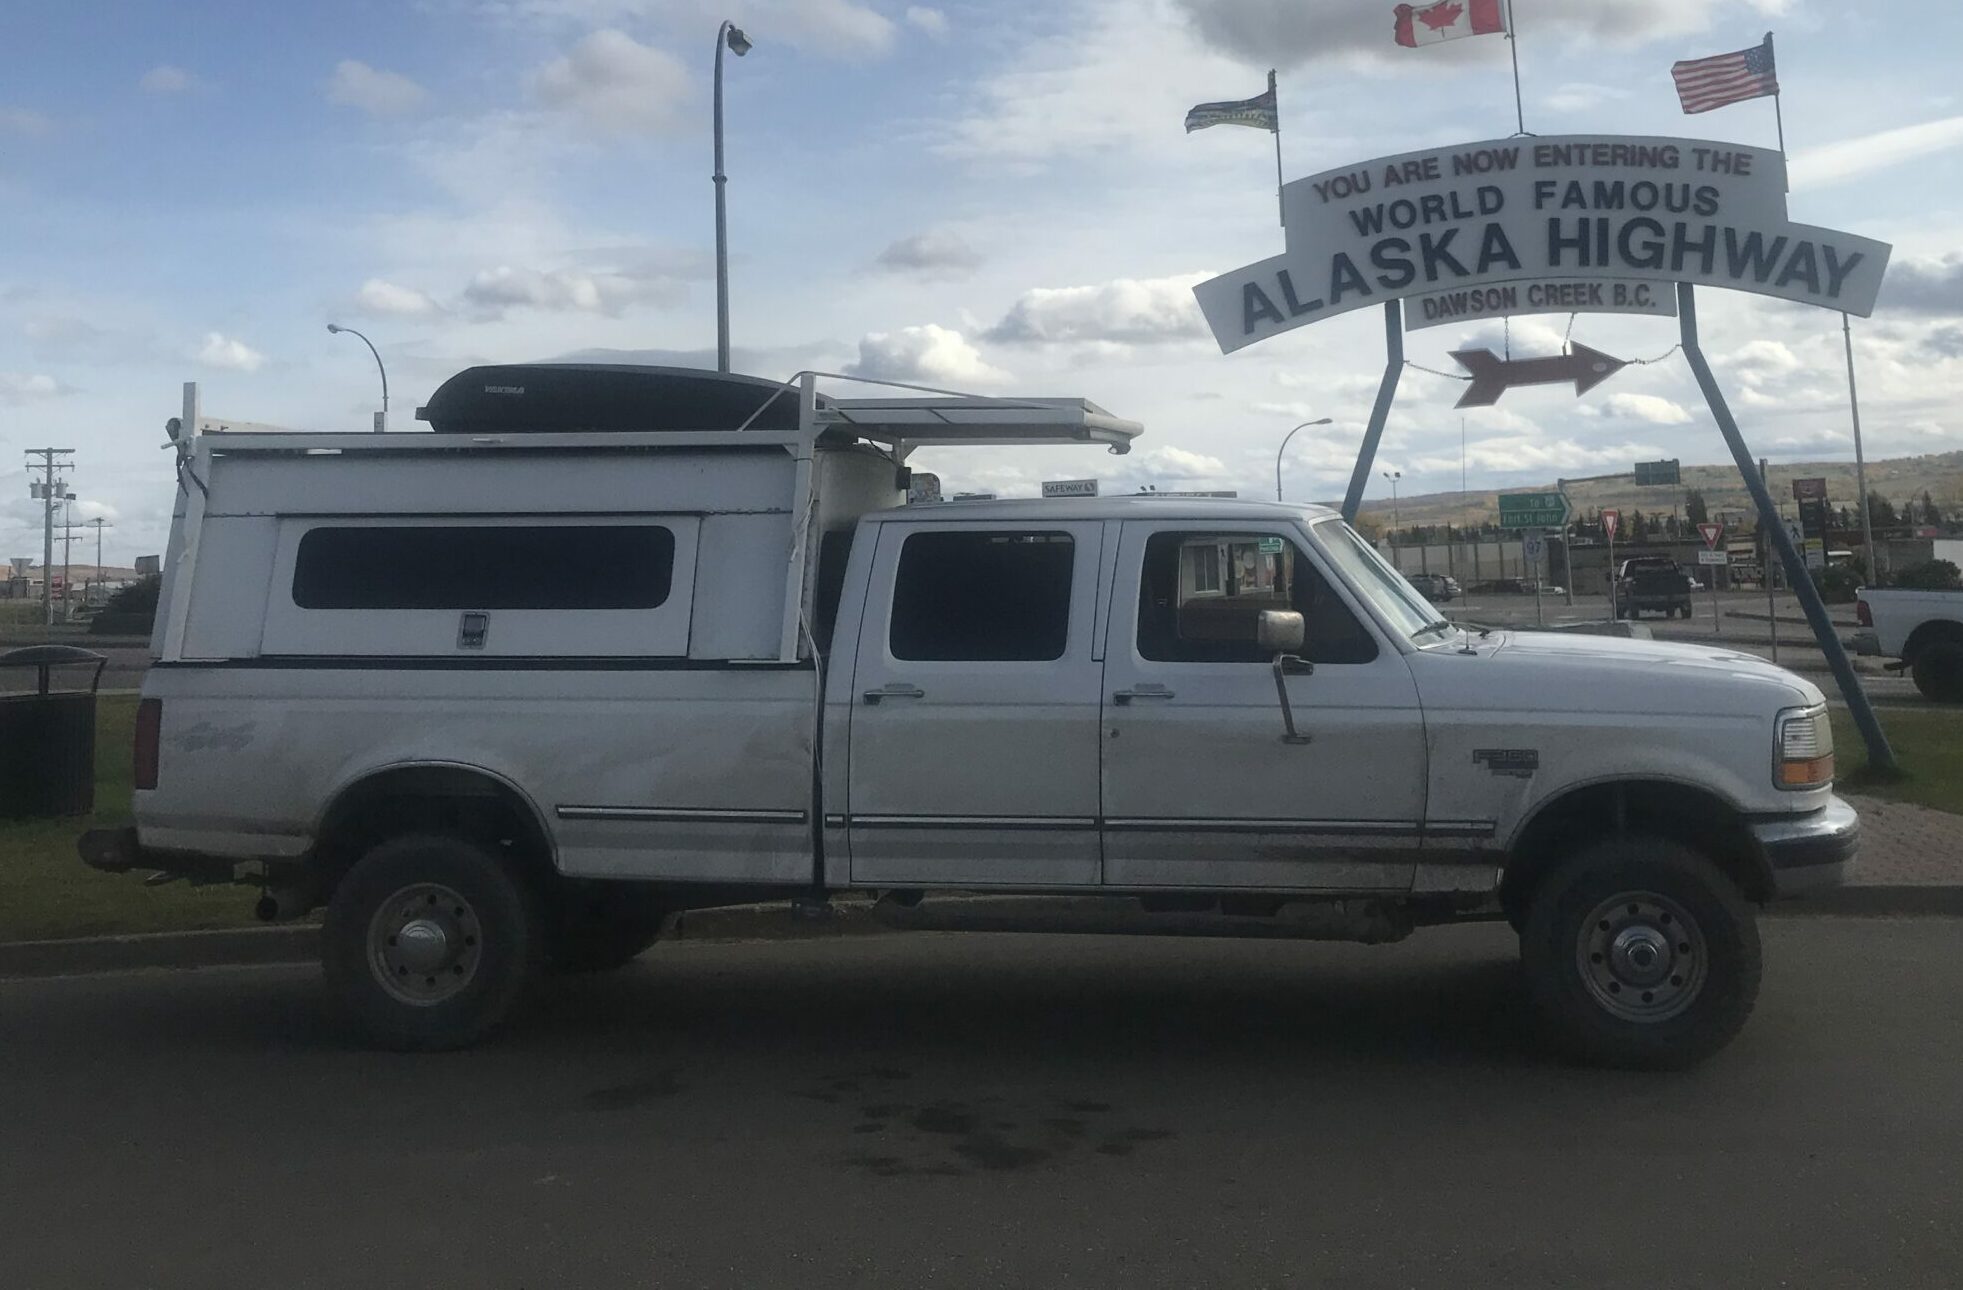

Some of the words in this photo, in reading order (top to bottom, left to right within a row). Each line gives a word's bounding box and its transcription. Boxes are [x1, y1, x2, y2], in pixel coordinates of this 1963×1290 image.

[1313, 170, 1371, 203] YOU
[1383, 157, 1441, 188] ARE
[1452, 147, 1520, 176] NOW
[1534, 143, 1680, 169] ENTERING
[1692, 148, 1754, 176] THE
[1349, 185, 1504, 237] WORLD
[1534, 180, 1720, 217] FAMOUS
[1242, 222, 1522, 335] ALASKA
[1548, 216, 1865, 298] HIGHWAY
[1422, 286, 1517, 320] DAWSON
[1528, 283, 1603, 307] CREEK
[1613, 283, 1657, 308] B.C.
[1045, 484, 1083, 494] SAFEWAY
